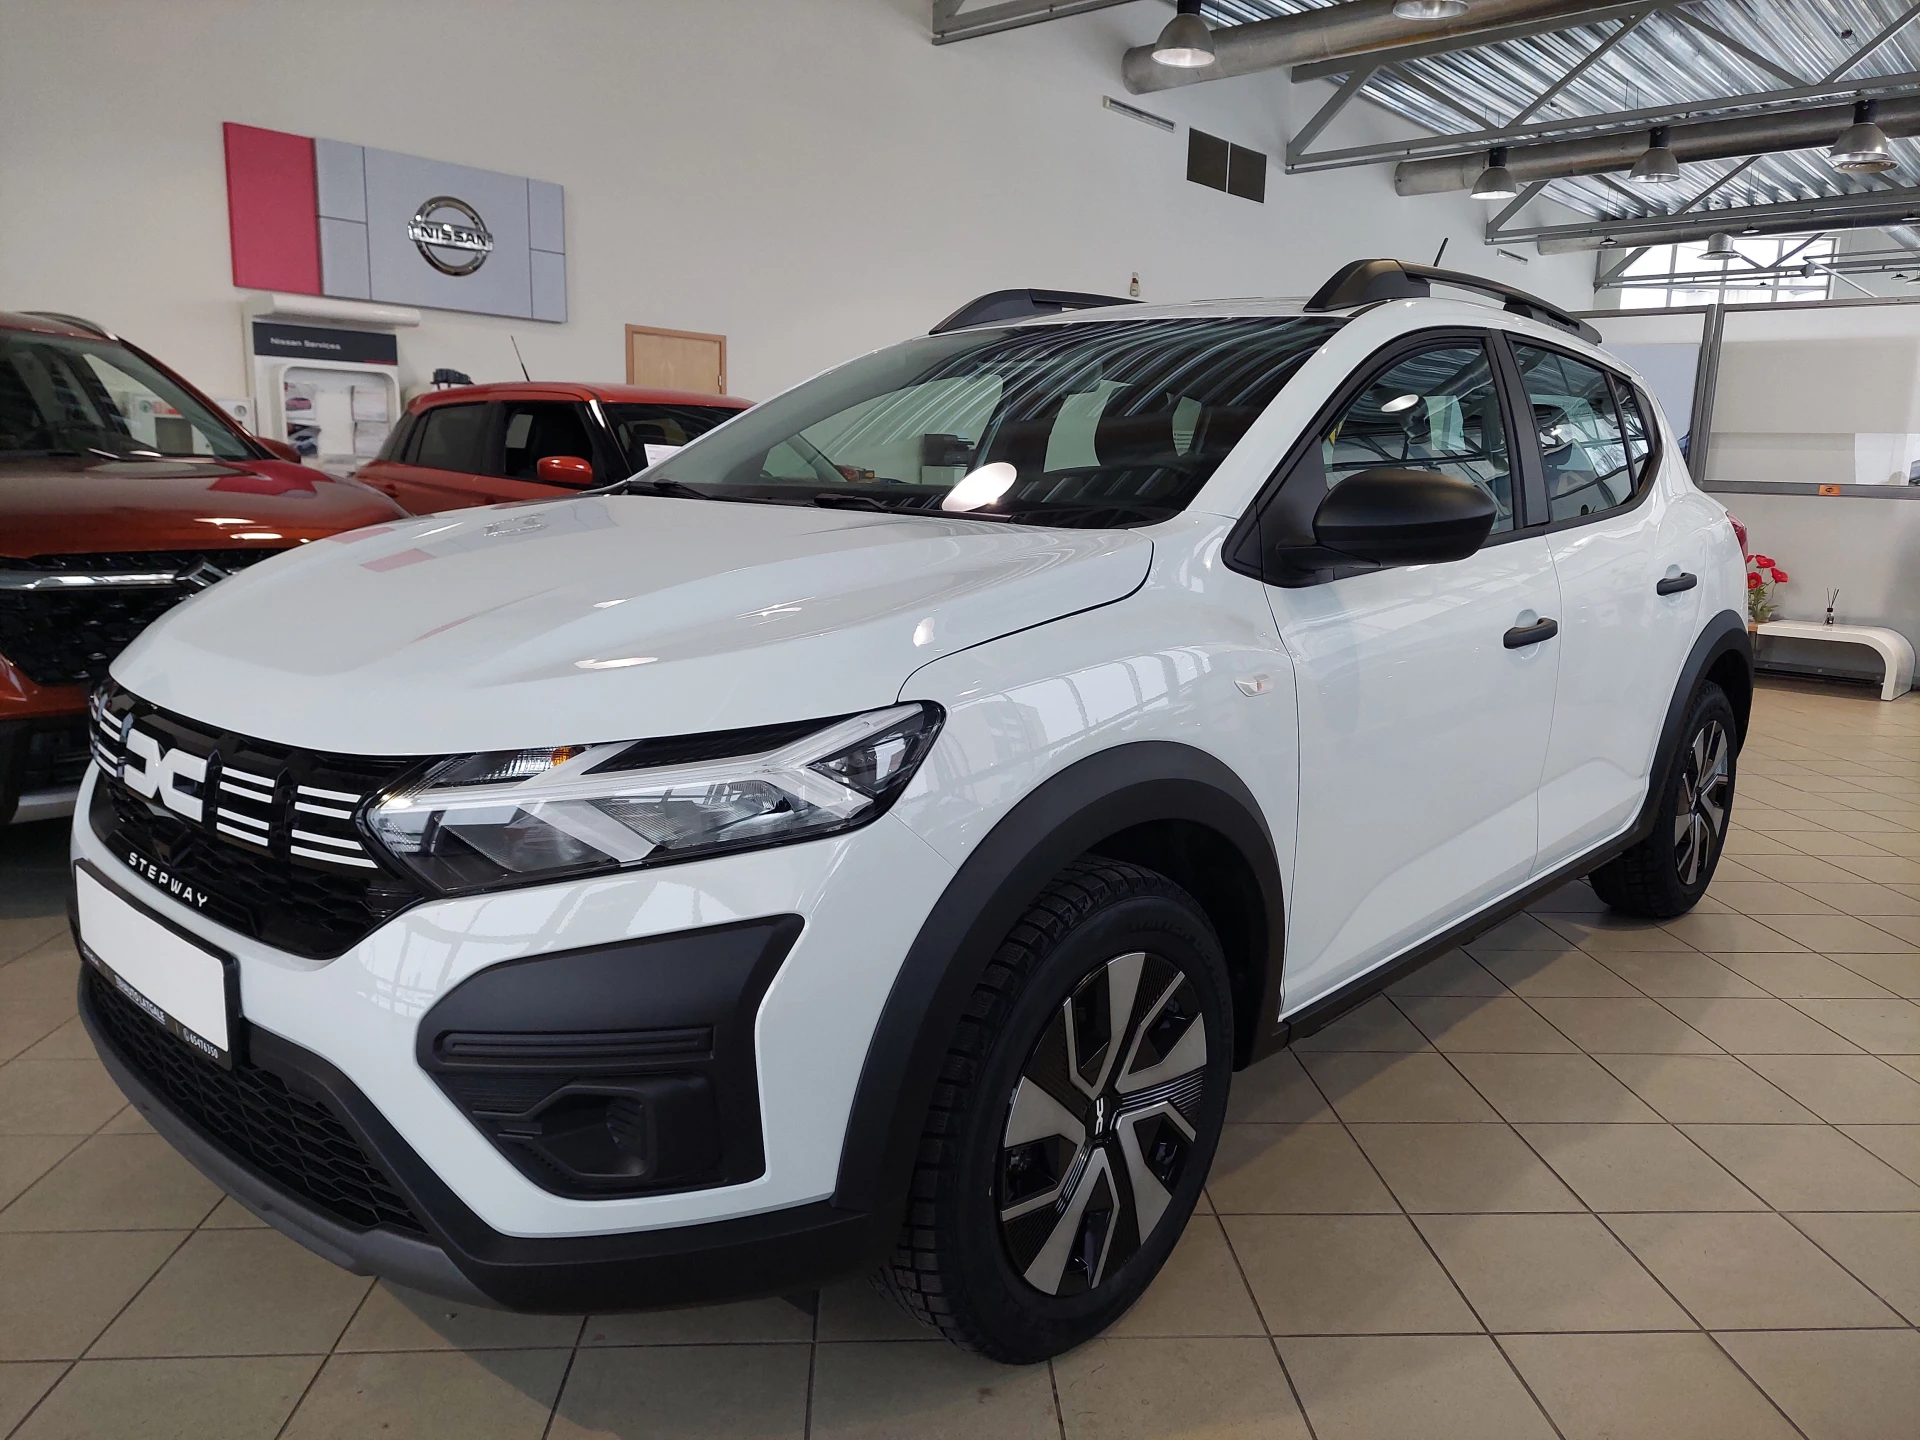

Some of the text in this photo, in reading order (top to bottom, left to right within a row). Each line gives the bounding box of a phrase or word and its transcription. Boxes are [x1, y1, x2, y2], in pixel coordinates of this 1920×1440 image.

[420, 225, 487, 247] NISSAN
[269, 336, 342, 350] Nissan Services
[128, 851, 208, 908] STEPWAY
